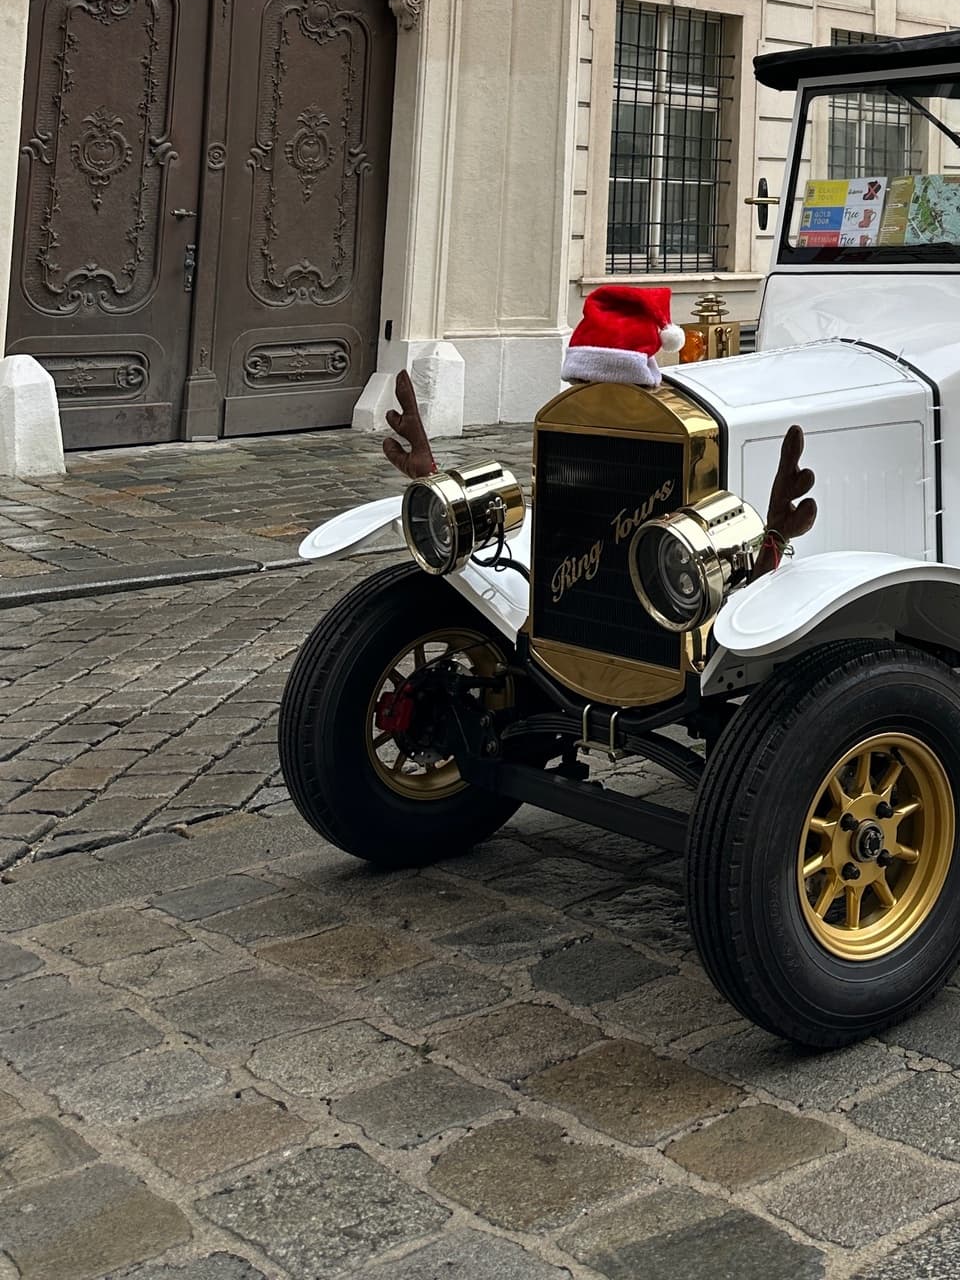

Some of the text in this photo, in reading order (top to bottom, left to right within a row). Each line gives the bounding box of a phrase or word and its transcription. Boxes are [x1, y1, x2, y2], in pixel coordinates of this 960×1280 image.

[844, 207, 859, 221] Free
[840, 233, 856, 247] Free
[551, 479, 675, 603] Ring Tours
